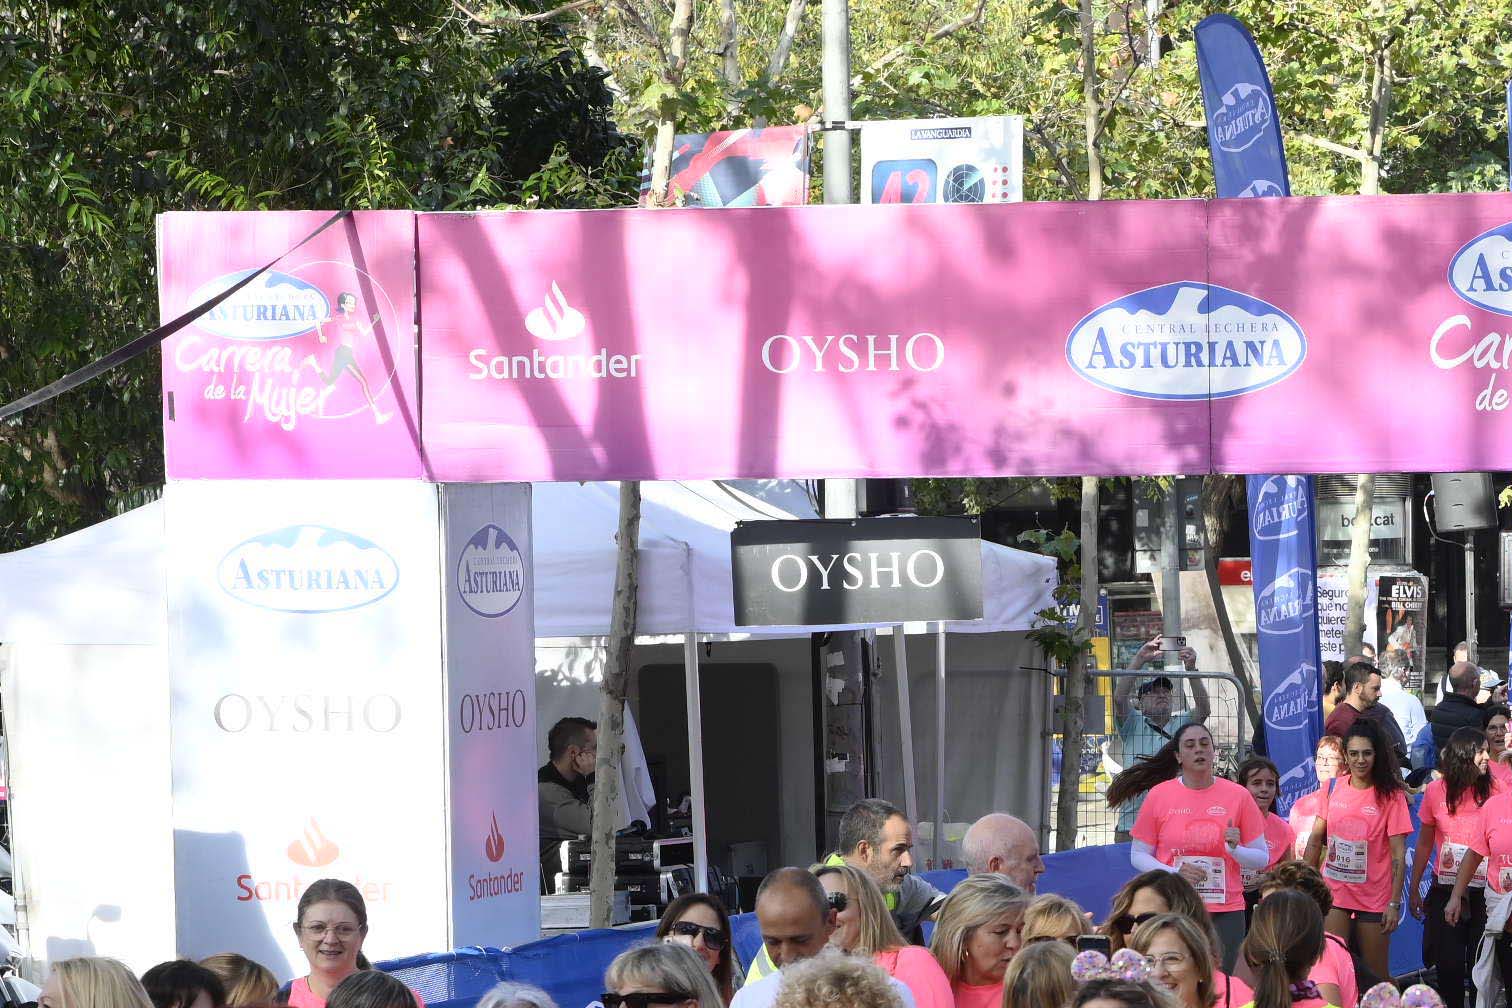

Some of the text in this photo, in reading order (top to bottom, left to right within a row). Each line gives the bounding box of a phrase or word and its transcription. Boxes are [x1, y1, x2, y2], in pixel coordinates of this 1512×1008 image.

[1121, 320, 1280, 335] CENTRAL LECHERA
[175, 336, 294, 374] Carrera
[468, 347, 642, 379] Santander
[761, 332, 944, 375] OYSHO
[1085, 324, 1287, 371] ASTURIANA
[204, 377, 335, 431] de la Mujer
[1475, 372, 1510, 412] de
[232, 558, 388, 590] ASTURIANA
[463, 560, 521, 594] ASTURIANA
[770, 550, 945, 593] OYSHO
[1391, 585, 1422, 598] ELVIS
[213, 693, 402, 733] OYSHO
[460, 689, 526, 733] OYSHO
[468, 870, 525, 902] Santander
